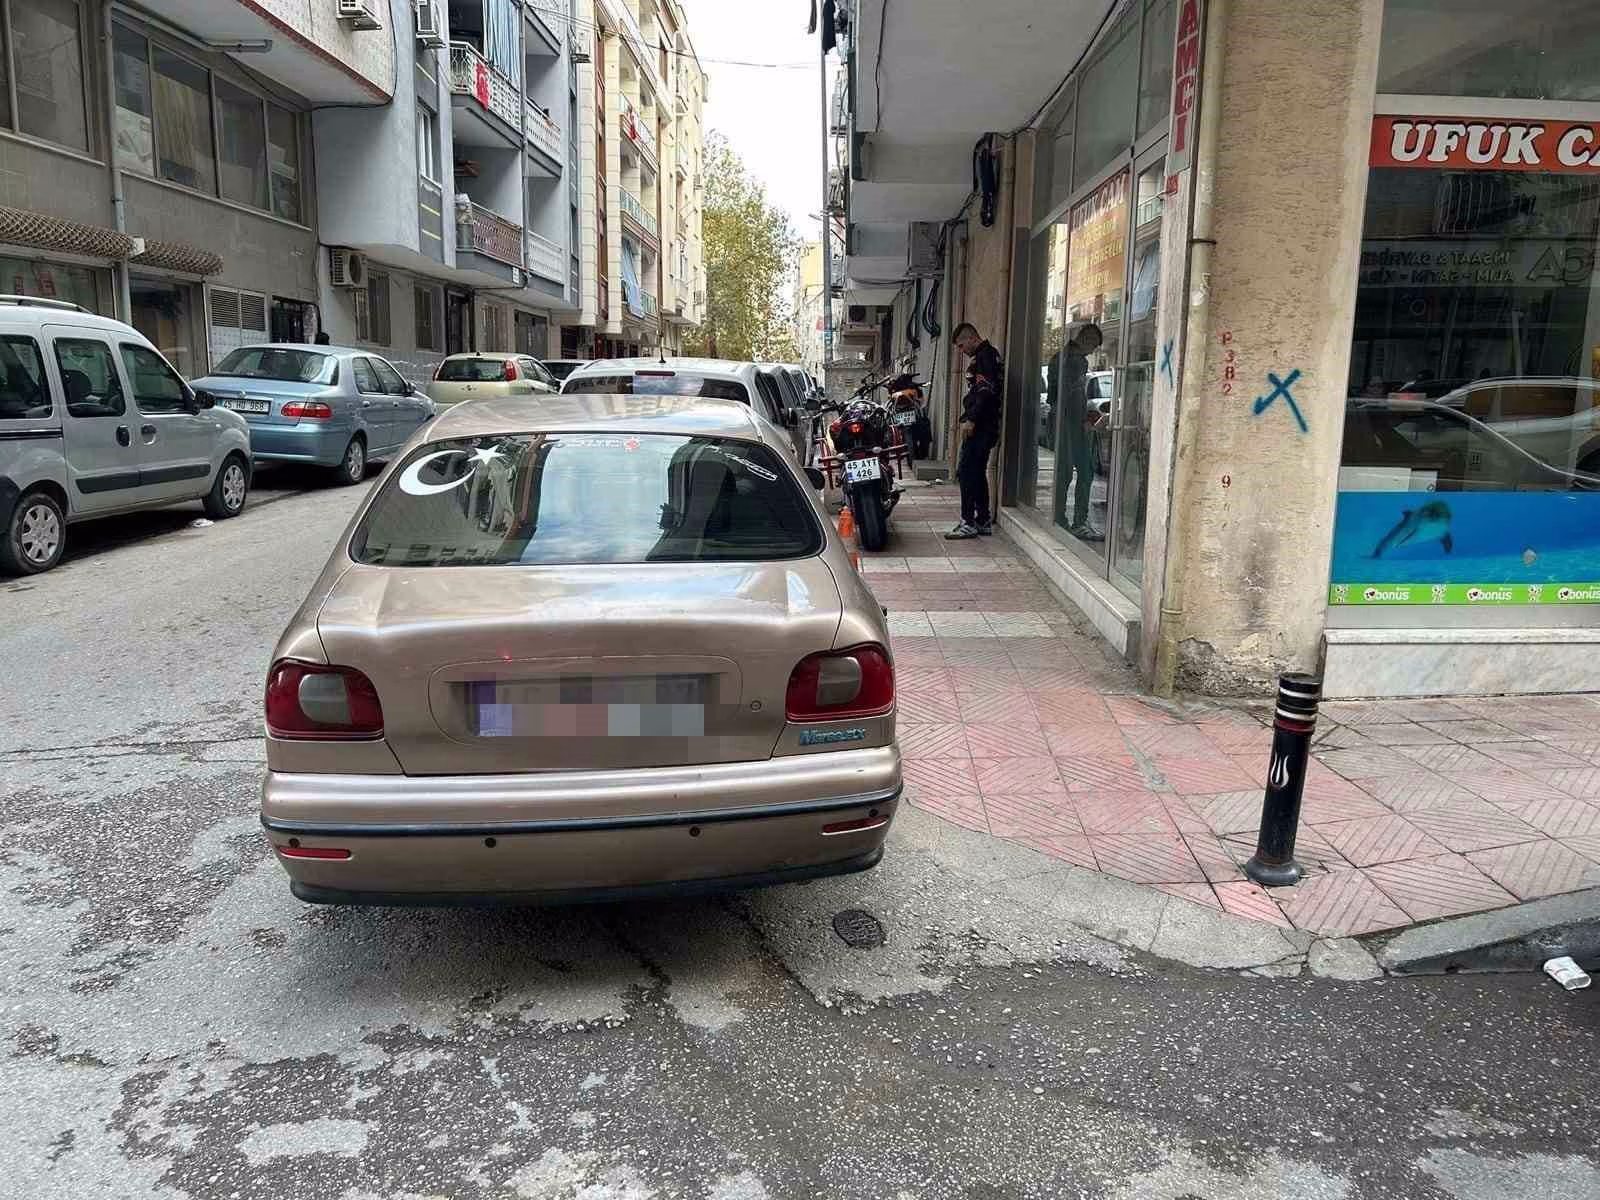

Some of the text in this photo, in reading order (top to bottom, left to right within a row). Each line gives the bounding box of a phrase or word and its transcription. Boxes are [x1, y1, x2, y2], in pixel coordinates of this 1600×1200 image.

[1391, 122, 1545, 165] UFUK
[856, 469, 873, 477] 426
[1374, 588, 1410, 601] bonus
[1477, 588, 1513, 601] bonus
